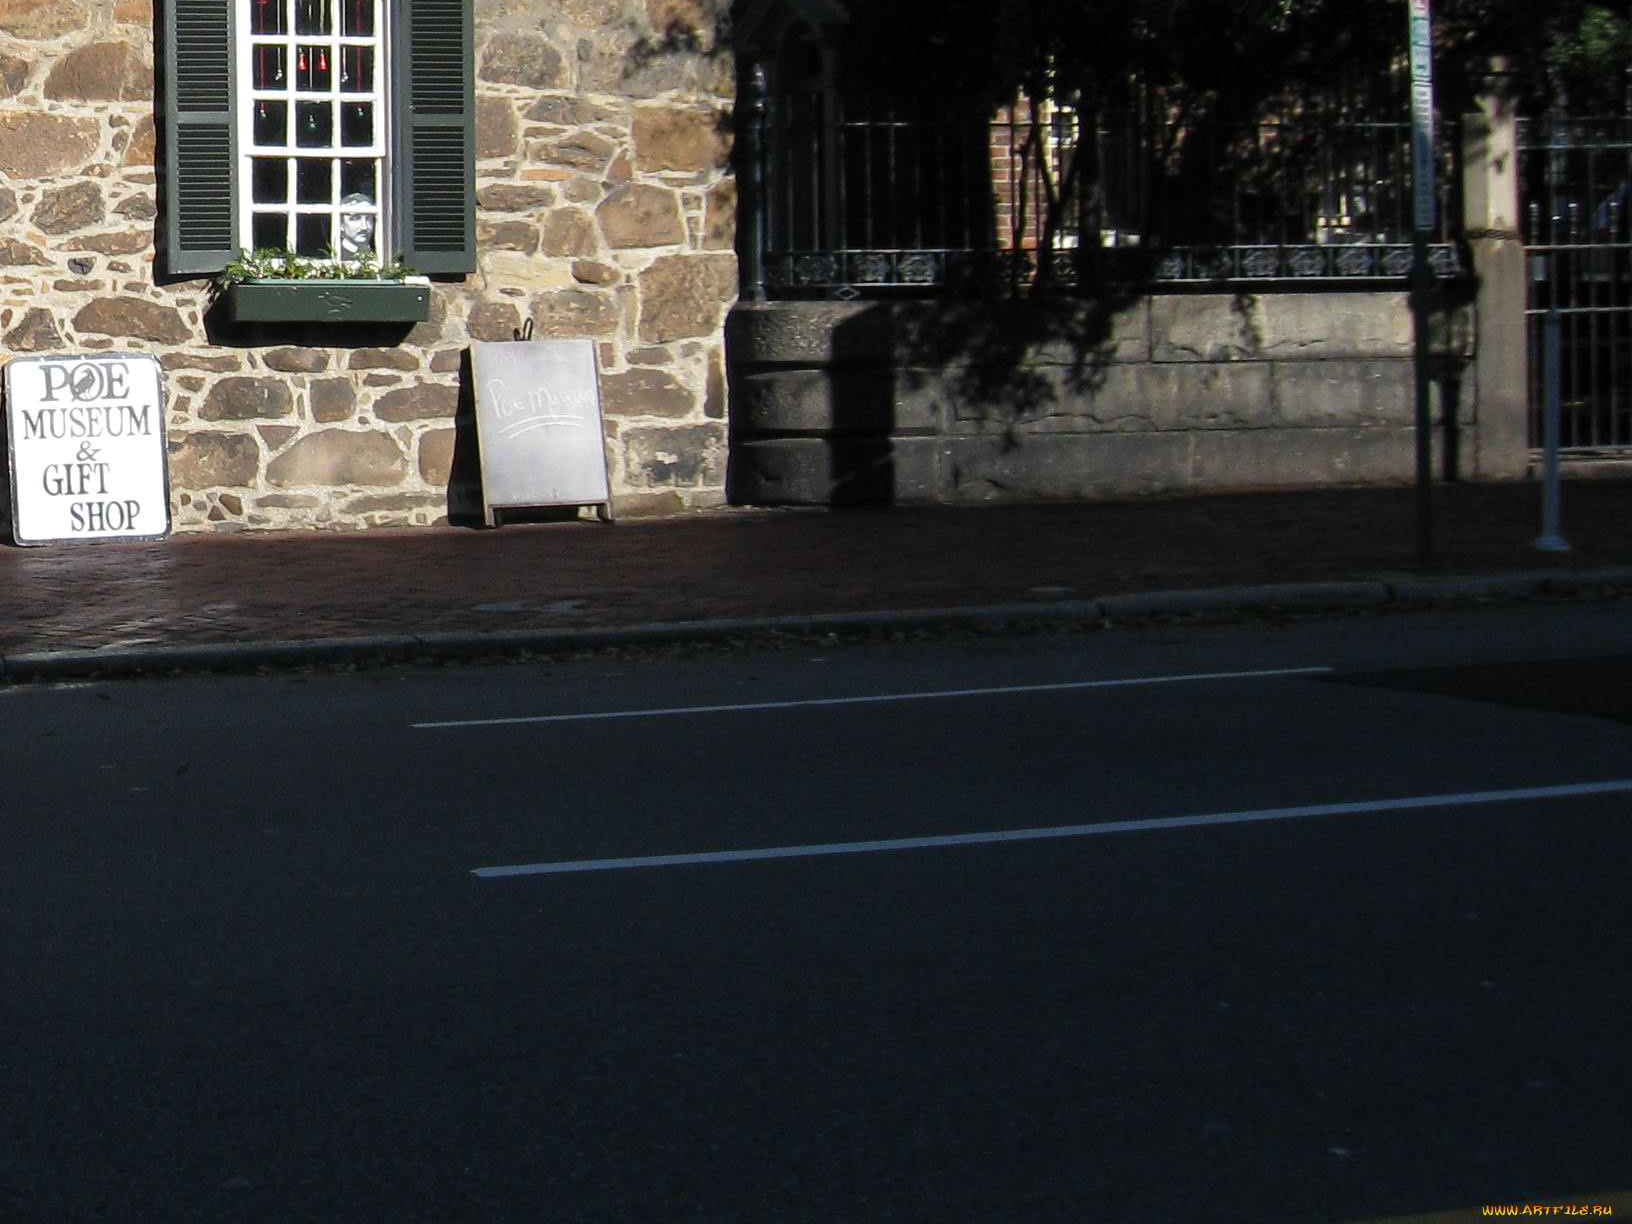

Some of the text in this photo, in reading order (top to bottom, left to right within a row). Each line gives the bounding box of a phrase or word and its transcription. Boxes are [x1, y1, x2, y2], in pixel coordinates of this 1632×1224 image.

[39, 362, 130, 403] POE
[21, 404, 152, 440] MUSEUM
[76, 440, 101, 462] &
[43, 463, 110, 496] GIFT
[70, 500, 141, 532] SHOP
